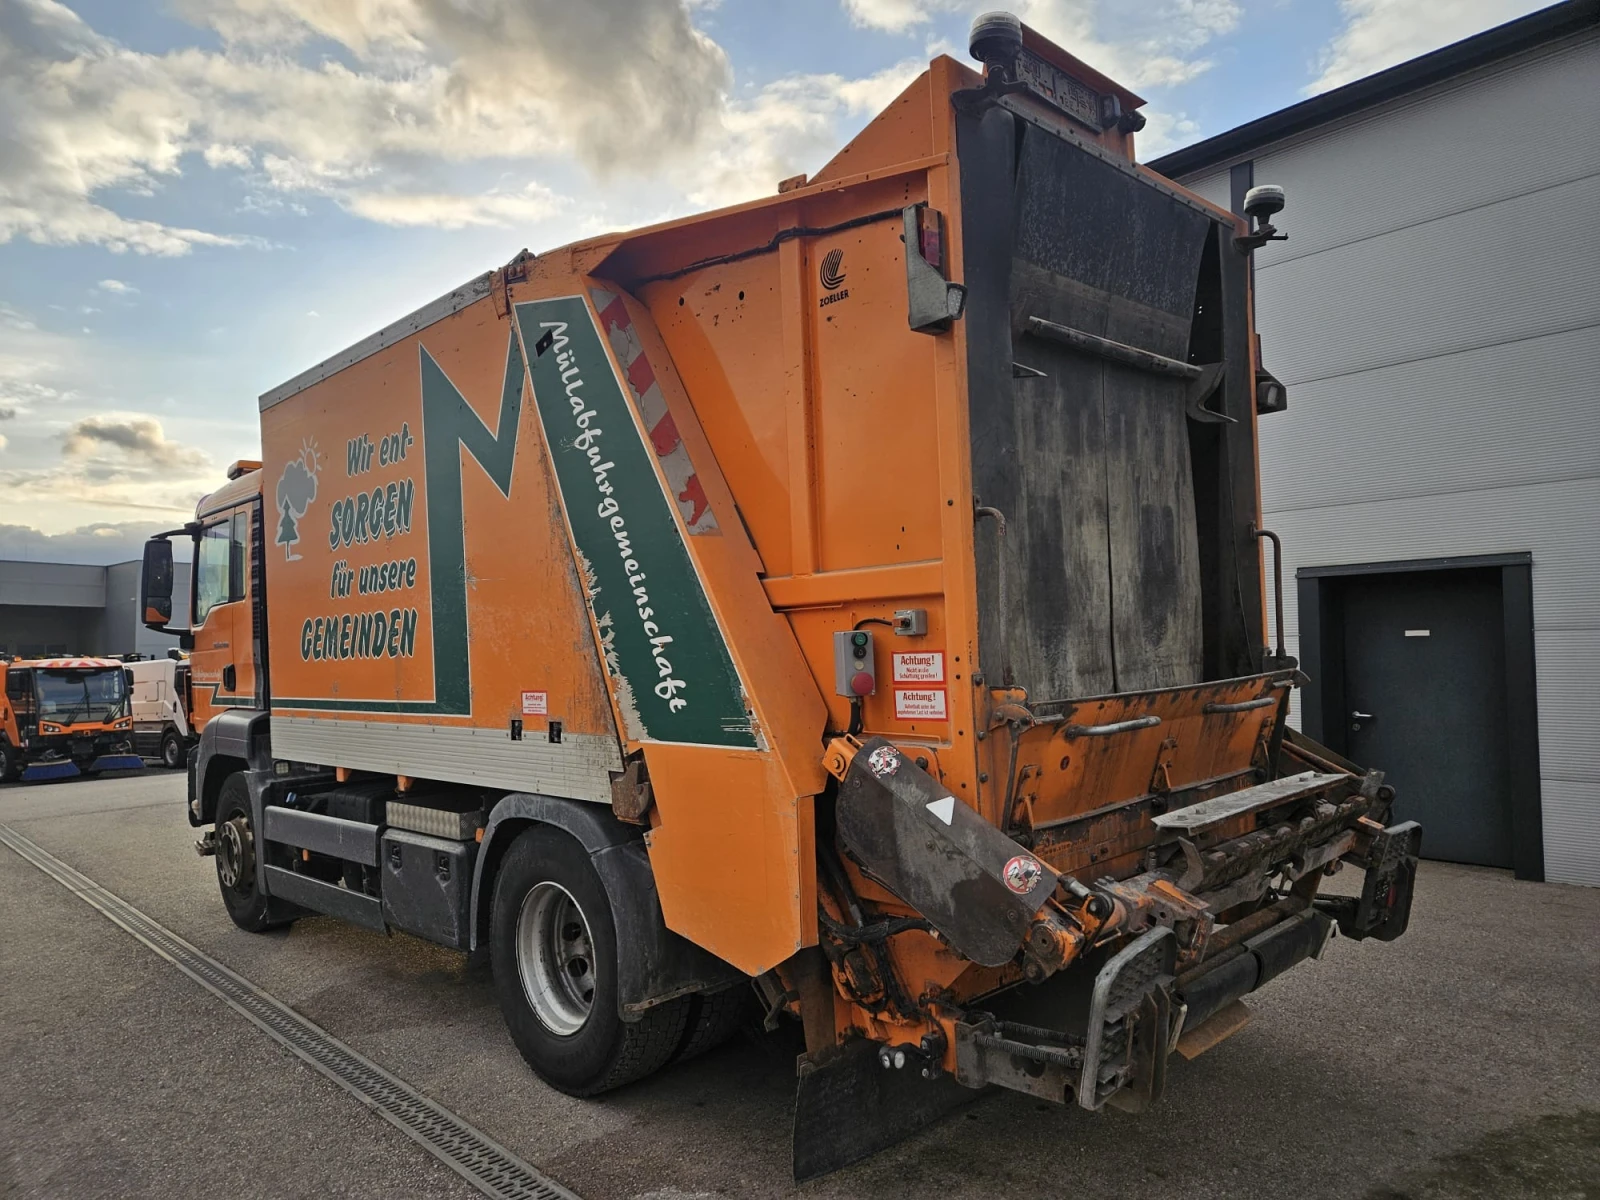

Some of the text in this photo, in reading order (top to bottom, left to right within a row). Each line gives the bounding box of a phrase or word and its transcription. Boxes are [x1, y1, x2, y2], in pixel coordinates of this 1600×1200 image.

[819, 289, 850, 308] ZOELLER
[347, 421, 413, 478] Wir ent-
[329, 477, 415, 551] SORGEN
[539, 321, 688, 714] Müllabfuhrgemeinschaft
[331, 557, 416, 599] für unsere
[301, 607, 418, 661] GEMEINDEN
